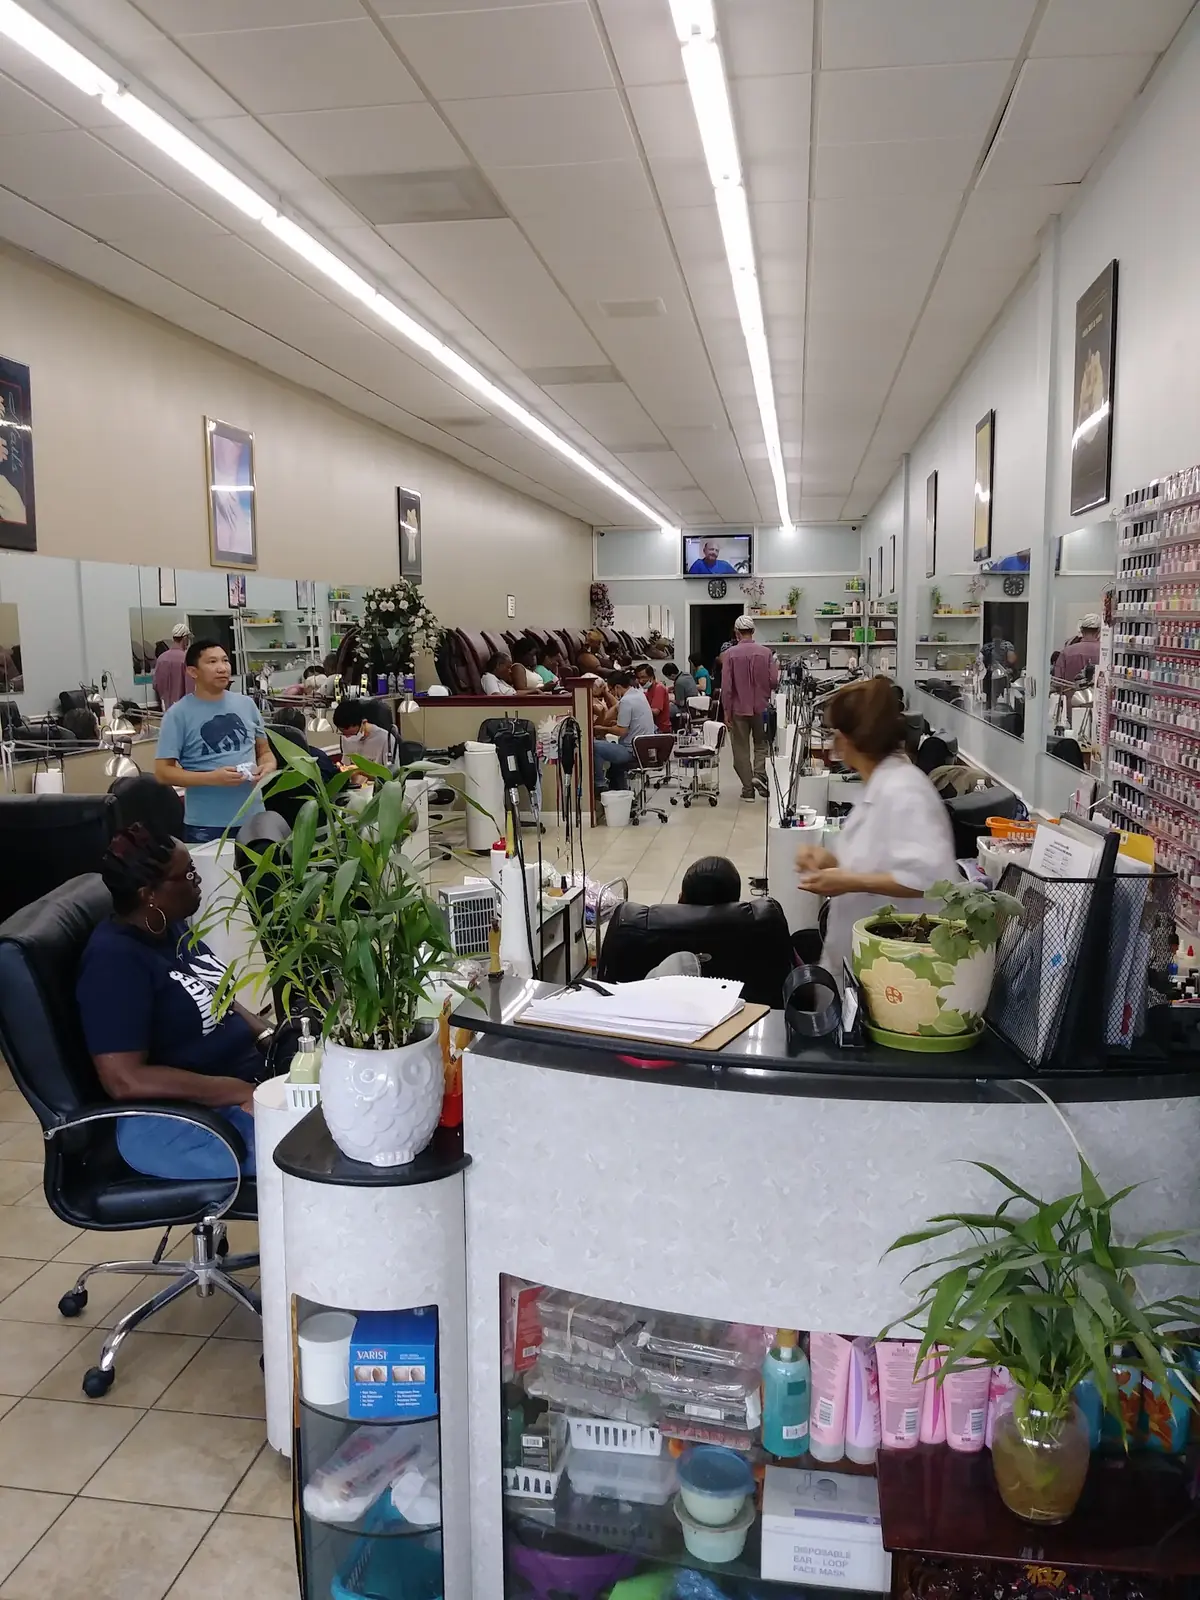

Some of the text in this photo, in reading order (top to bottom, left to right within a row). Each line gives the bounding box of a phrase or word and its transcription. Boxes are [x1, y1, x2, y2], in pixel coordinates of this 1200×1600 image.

[793, 1545, 851, 1559] DISPOSABLE
[793, 1555, 812, 1564] EAR
[822, 1559, 848, 1568] LOOP
[793, 1565, 845, 1577] FACE MASK
